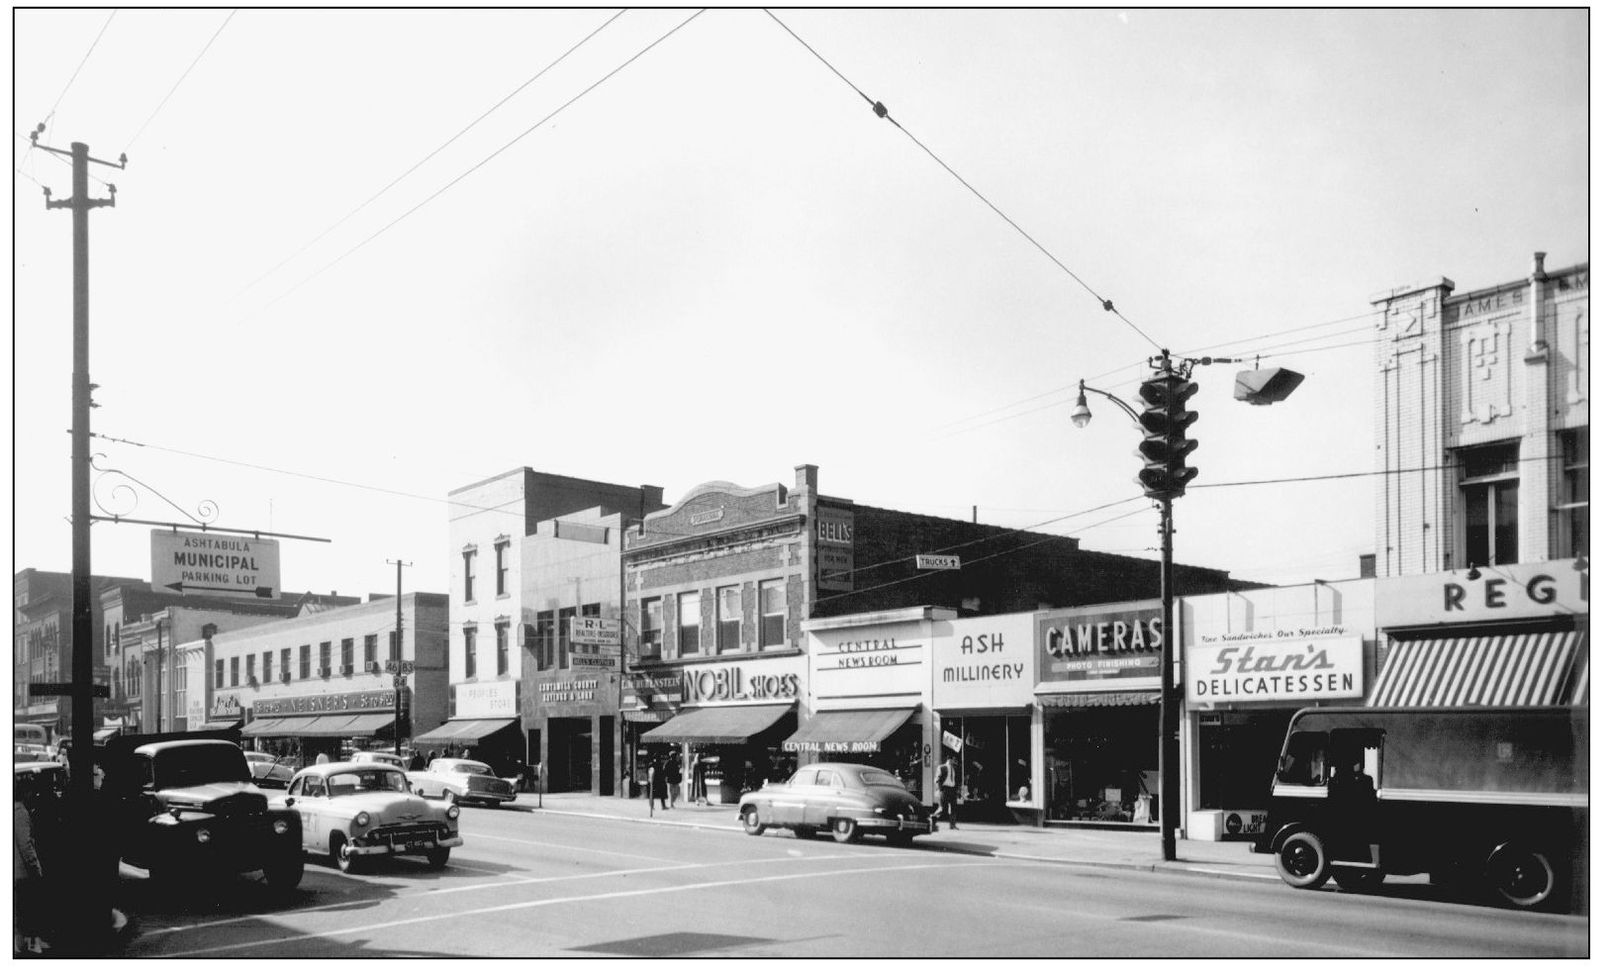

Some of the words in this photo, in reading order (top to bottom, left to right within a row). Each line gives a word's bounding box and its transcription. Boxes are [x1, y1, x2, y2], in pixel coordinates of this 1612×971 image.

[184, 537, 250, 552] ASHTABULA
[174, 552, 259, 571] MUNICIPAL
[921, 558, 948, 567] TRUCKS
[181, 571, 229, 583] PARKING
[236, 575, 257, 585] LOT
[1444, 572, 1588, 612] REG
[961, 632, 1004, 655] ASH
[1046, 617, 1162, 655] CAMERAS
[1222, 633, 1273, 642] Sandwiches
[1277, 630, 1294, 638] Our
[838, 637, 898, 653] CENTRAL
[838, 656, 865, 669] NEWS
[869, 654, 898, 668] ROOM
[1066, 660, 1093, 670] PHOTO
[1097, 658, 1141, 668] FINISHING
[1210, 643, 1335, 675] Stan's
[386, 663, 397, 672] 46
[403, 662, 413, 673] 83
[943, 663, 1023, 683] MILLINERY
[394, 678, 405, 688] 84
[684, 667, 747, 701] NOBIL
[750, 673, 799, 698] SHOES
[1197, 673, 1353, 696] DELICATESSEN
[784, 741, 821, 752] CENTRAL
[824, 741, 848, 752] NEWS
[852, 741, 877, 752] ROOM
